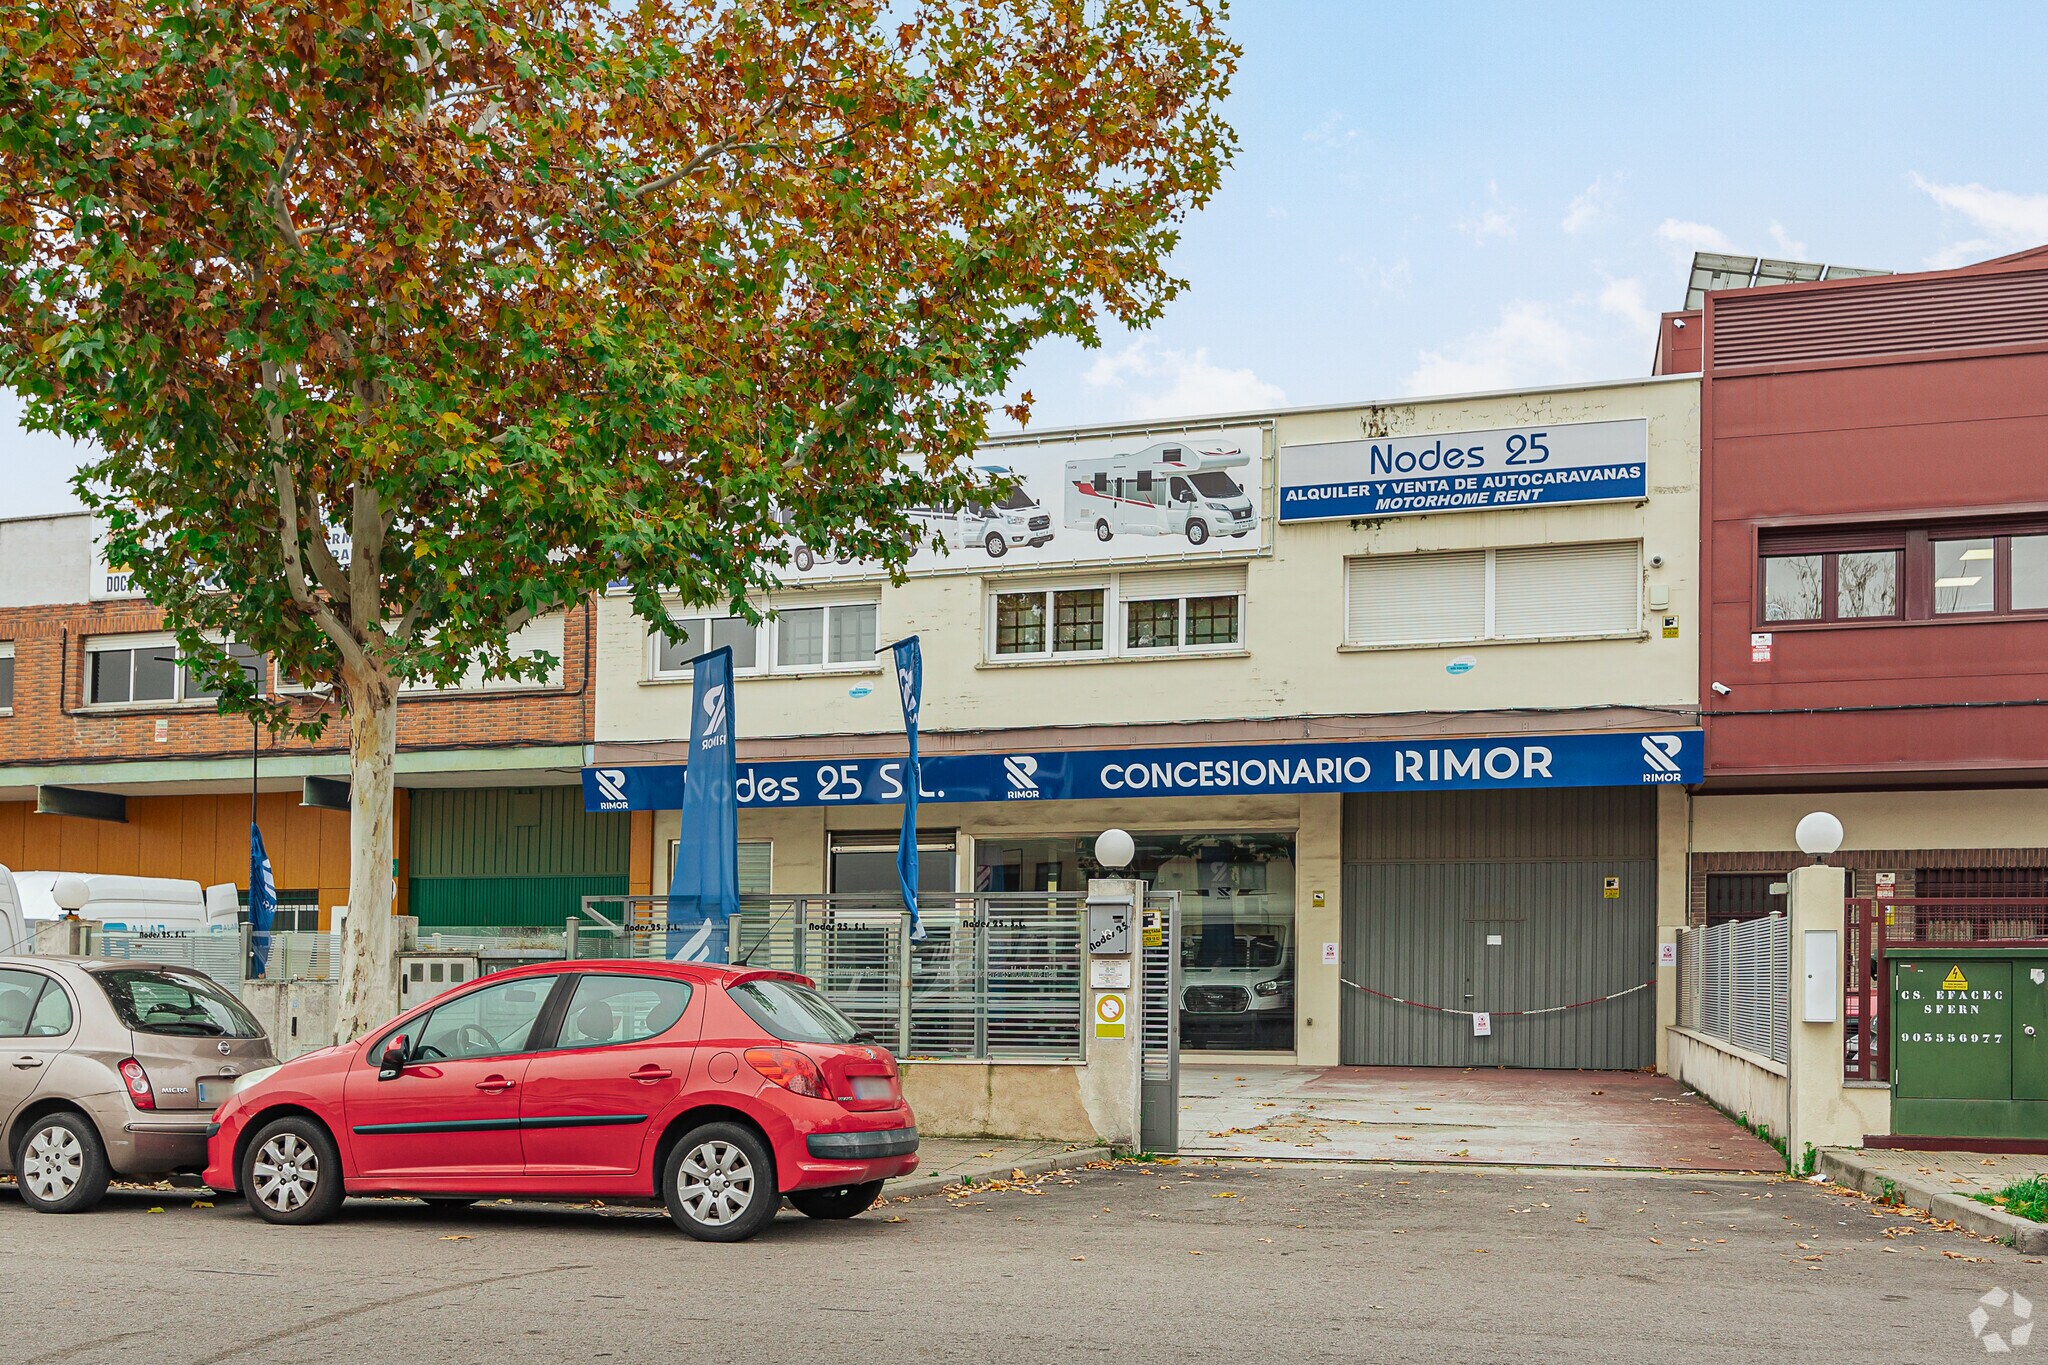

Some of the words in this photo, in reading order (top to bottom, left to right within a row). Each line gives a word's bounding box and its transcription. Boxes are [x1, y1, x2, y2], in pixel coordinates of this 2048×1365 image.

[1370, 440, 1485, 475] Nodes
[1504, 432, 1550, 466] 25
[1285, 484, 1370, 502] ALQUILER
[1375, 483, 1387, 495] Y
[1391, 478, 1450, 494] VENTA
[1454, 477, 1478, 490] DE
[1482, 466, 1641, 489] AUTOCARAVANAS
[1375, 491, 1490, 511] MOTORHOME
[1493, 488, 1544, 503] RENT
[1100, 756, 1371, 790] CONCESIONARIO
[1395, 746, 1553, 782] RIMOR
[816, 765, 863, 800] 25
[879, 763, 946, 799] SL.
[1642, 773, 1682, 783] RIMOR
[1007, 790, 1040, 799] RIMOR
[600, 801, 629, 810] RIMOR
[624, 923, 650, 932] Nodes
[666, 923, 681, 931] S.L.
[808, 922, 835, 931] Nodes
[854, 922, 870, 931] S.L.
[962, 920, 990, 928] Nodes
[139, 931, 160, 939] Nodes
[1089, 931, 1115, 951] Nodes
[1936, 990, 2003, 1000] EFACEC
[1924, 1004, 1979, 1014] SFERN
